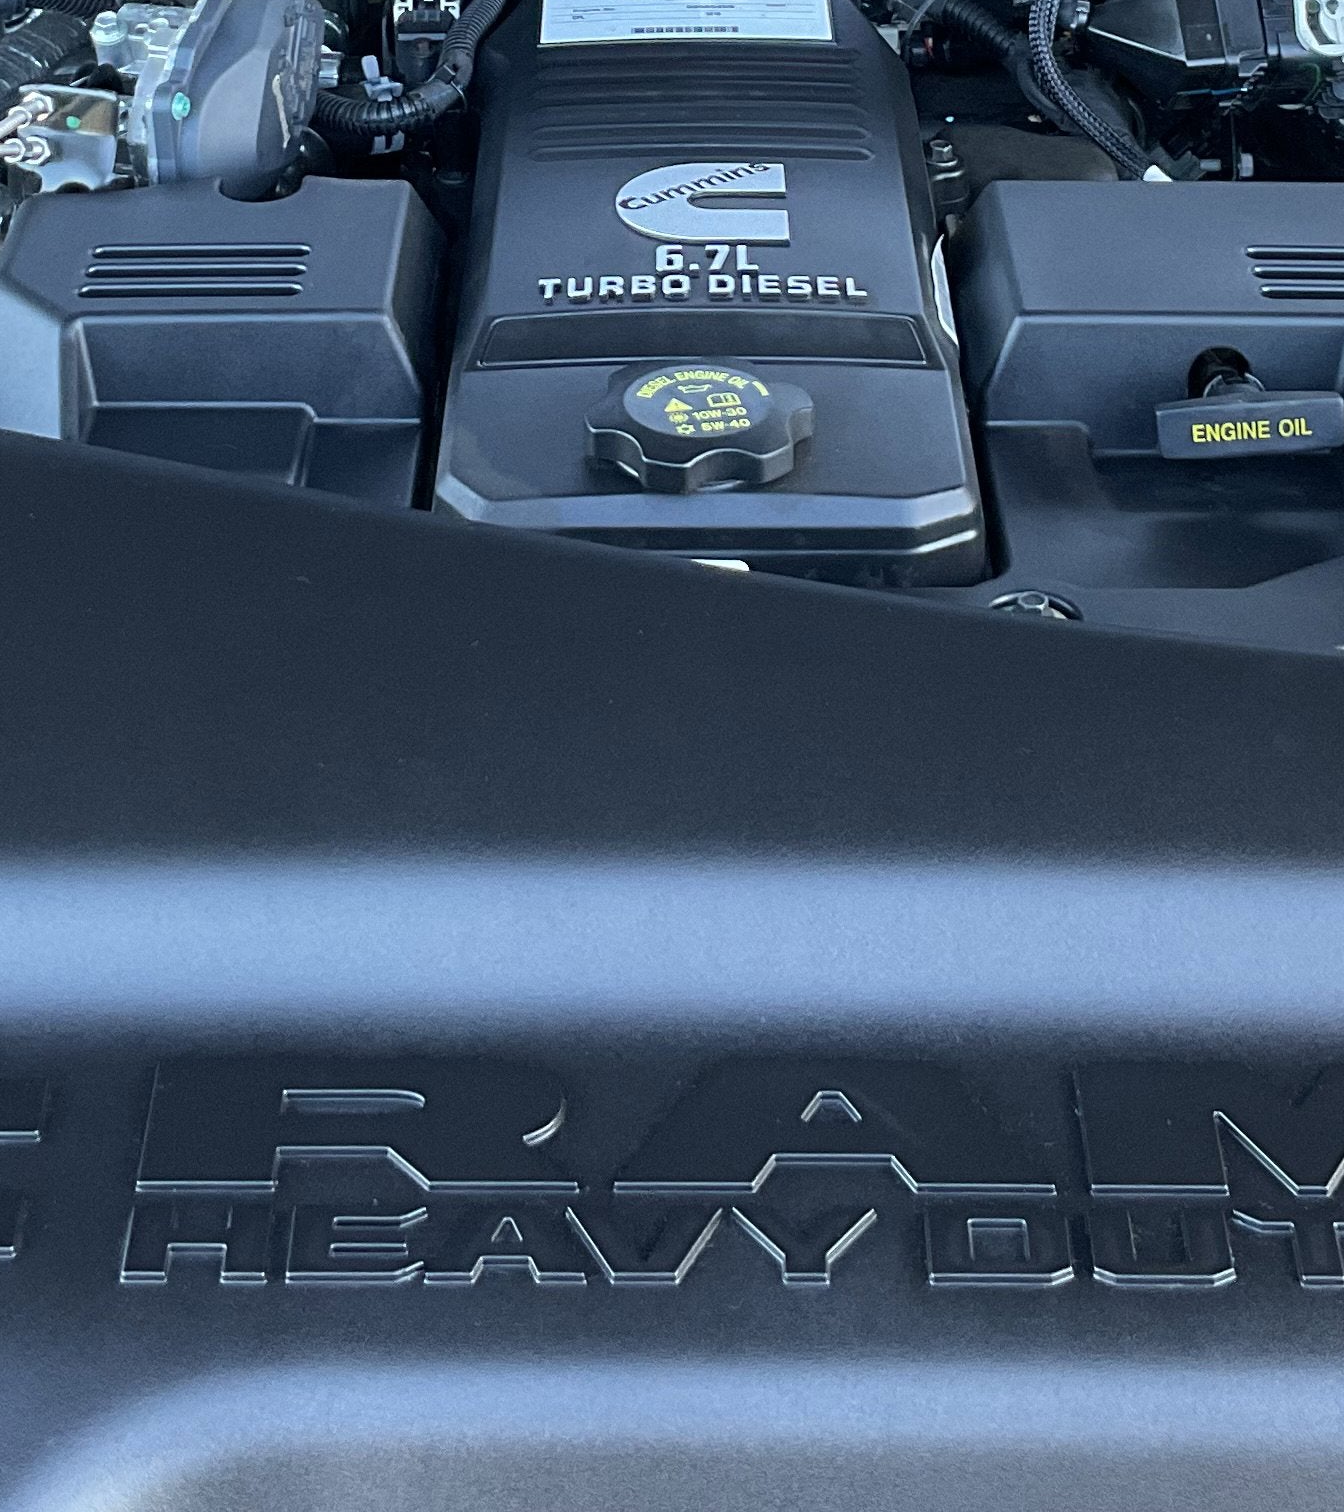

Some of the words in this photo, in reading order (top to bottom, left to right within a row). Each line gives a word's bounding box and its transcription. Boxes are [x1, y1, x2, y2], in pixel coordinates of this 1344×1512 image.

[618, 162, 771, 210] Cummins
[655, 243, 760, 275] 6.7L
[538, 274, 691, 303] TURBO
[707, 274, 869, 302] DIESEL
[636, 375, 676, 399] DIESEL
[674, 370, 730, 383] ENGINE
[728, 376, 750, 389] OIL
[692, 406, 748, 421] 10W-30
[1191, 420, 1271, 443] ENGINE
[1278, 417, 1313, 437] OIL
[118, 1202, 878, 1288] HEAVY
